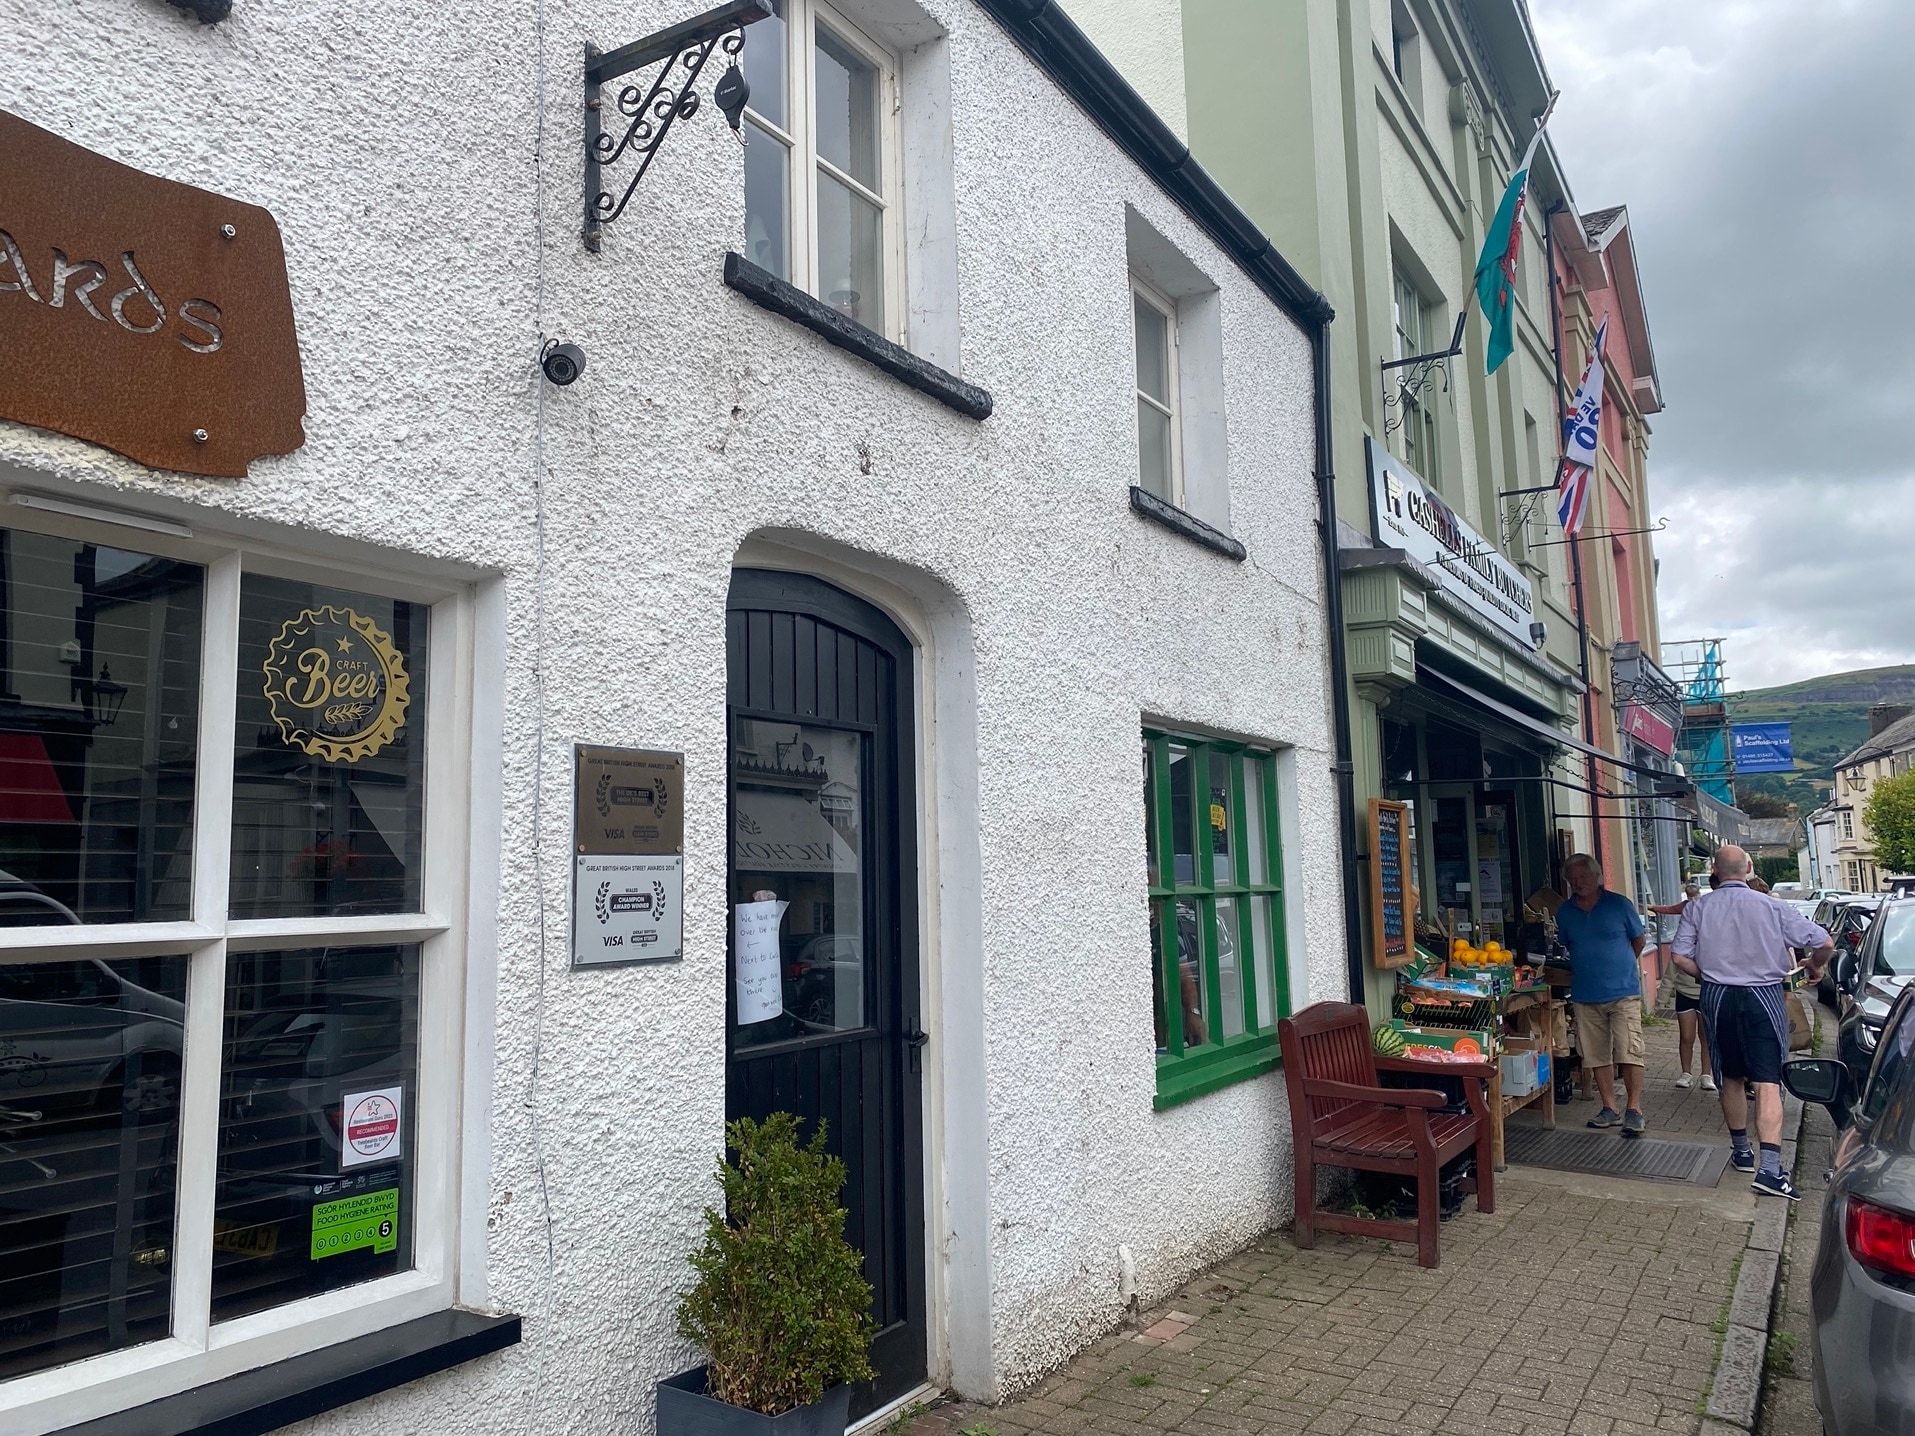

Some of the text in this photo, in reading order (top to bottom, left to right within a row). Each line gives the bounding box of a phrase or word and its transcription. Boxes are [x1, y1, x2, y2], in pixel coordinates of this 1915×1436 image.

[336, 660, 369, 671] CRAFT
[285, 647, 379, 709] Beer
[603, 828, 625, 839] VISA
[602, 936, 624, 947] VISA
[740, 955, 758, 965] Next
[760, 952, 766, 961] to
[743, 977, 754, 985] See
[356, 1124, 390, 1135] RECOMMENDED
[1781, 1182, 1793, 1194] N
[338, 1197, 373, 1211] HYLENDID
[374, 1192, 395, 1202] BWYD
[316, 1202, 394, 1225] FOOD HYGIENE RATING
[381, 1222, 390, 1236] 5
